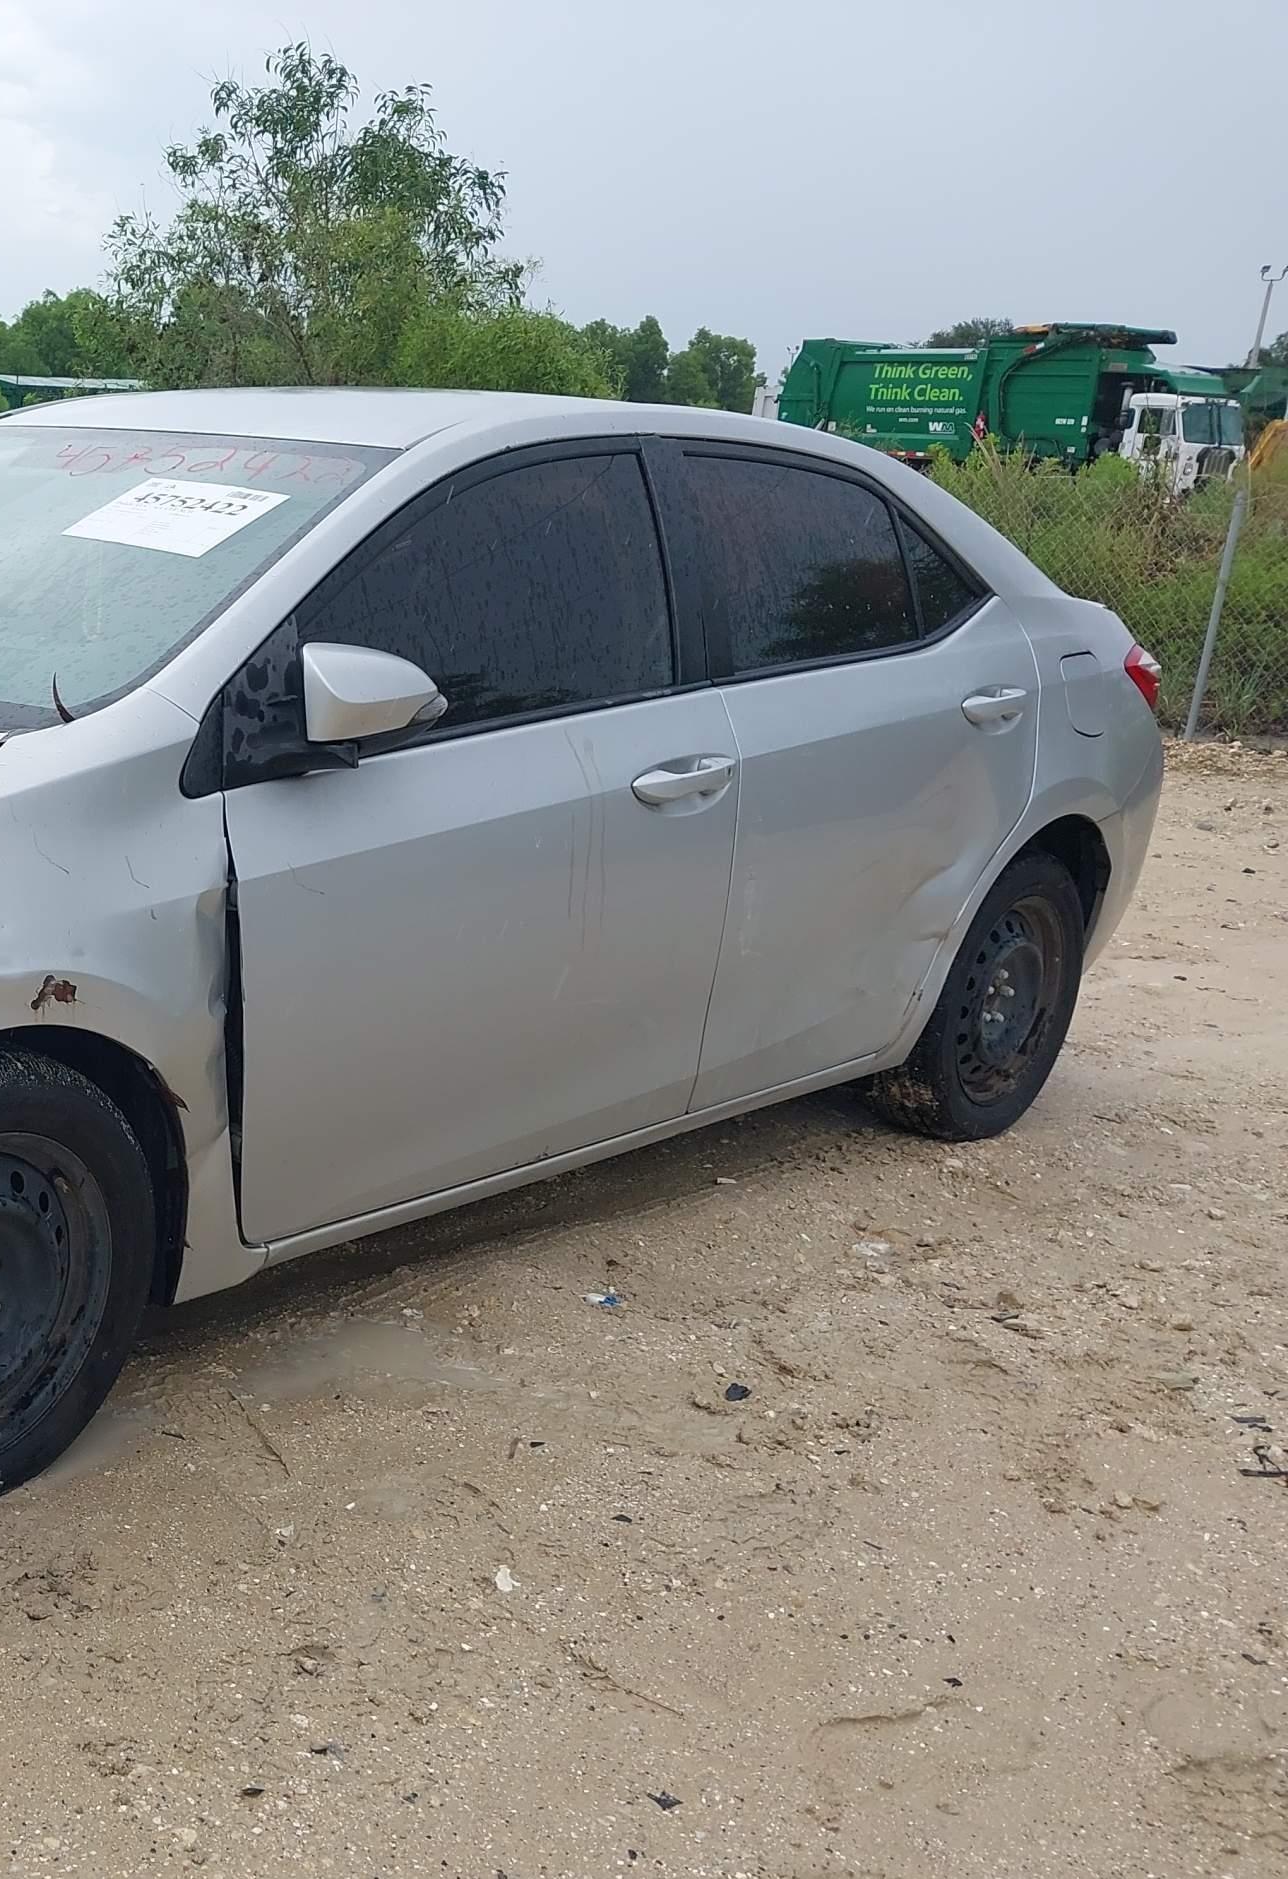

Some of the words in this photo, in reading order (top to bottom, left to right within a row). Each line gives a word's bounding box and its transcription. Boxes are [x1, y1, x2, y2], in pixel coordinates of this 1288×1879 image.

[873, 363, 917, 378] Think
[918, 363, 973, 381] Green,
[869, 384, 911, 400] Think
[914, 384, 963, 400] Clean.
[911, 406, 933, 414] burning
[934, 406, 955, 414] natural
[133, 491, 249, 516] 45752422
